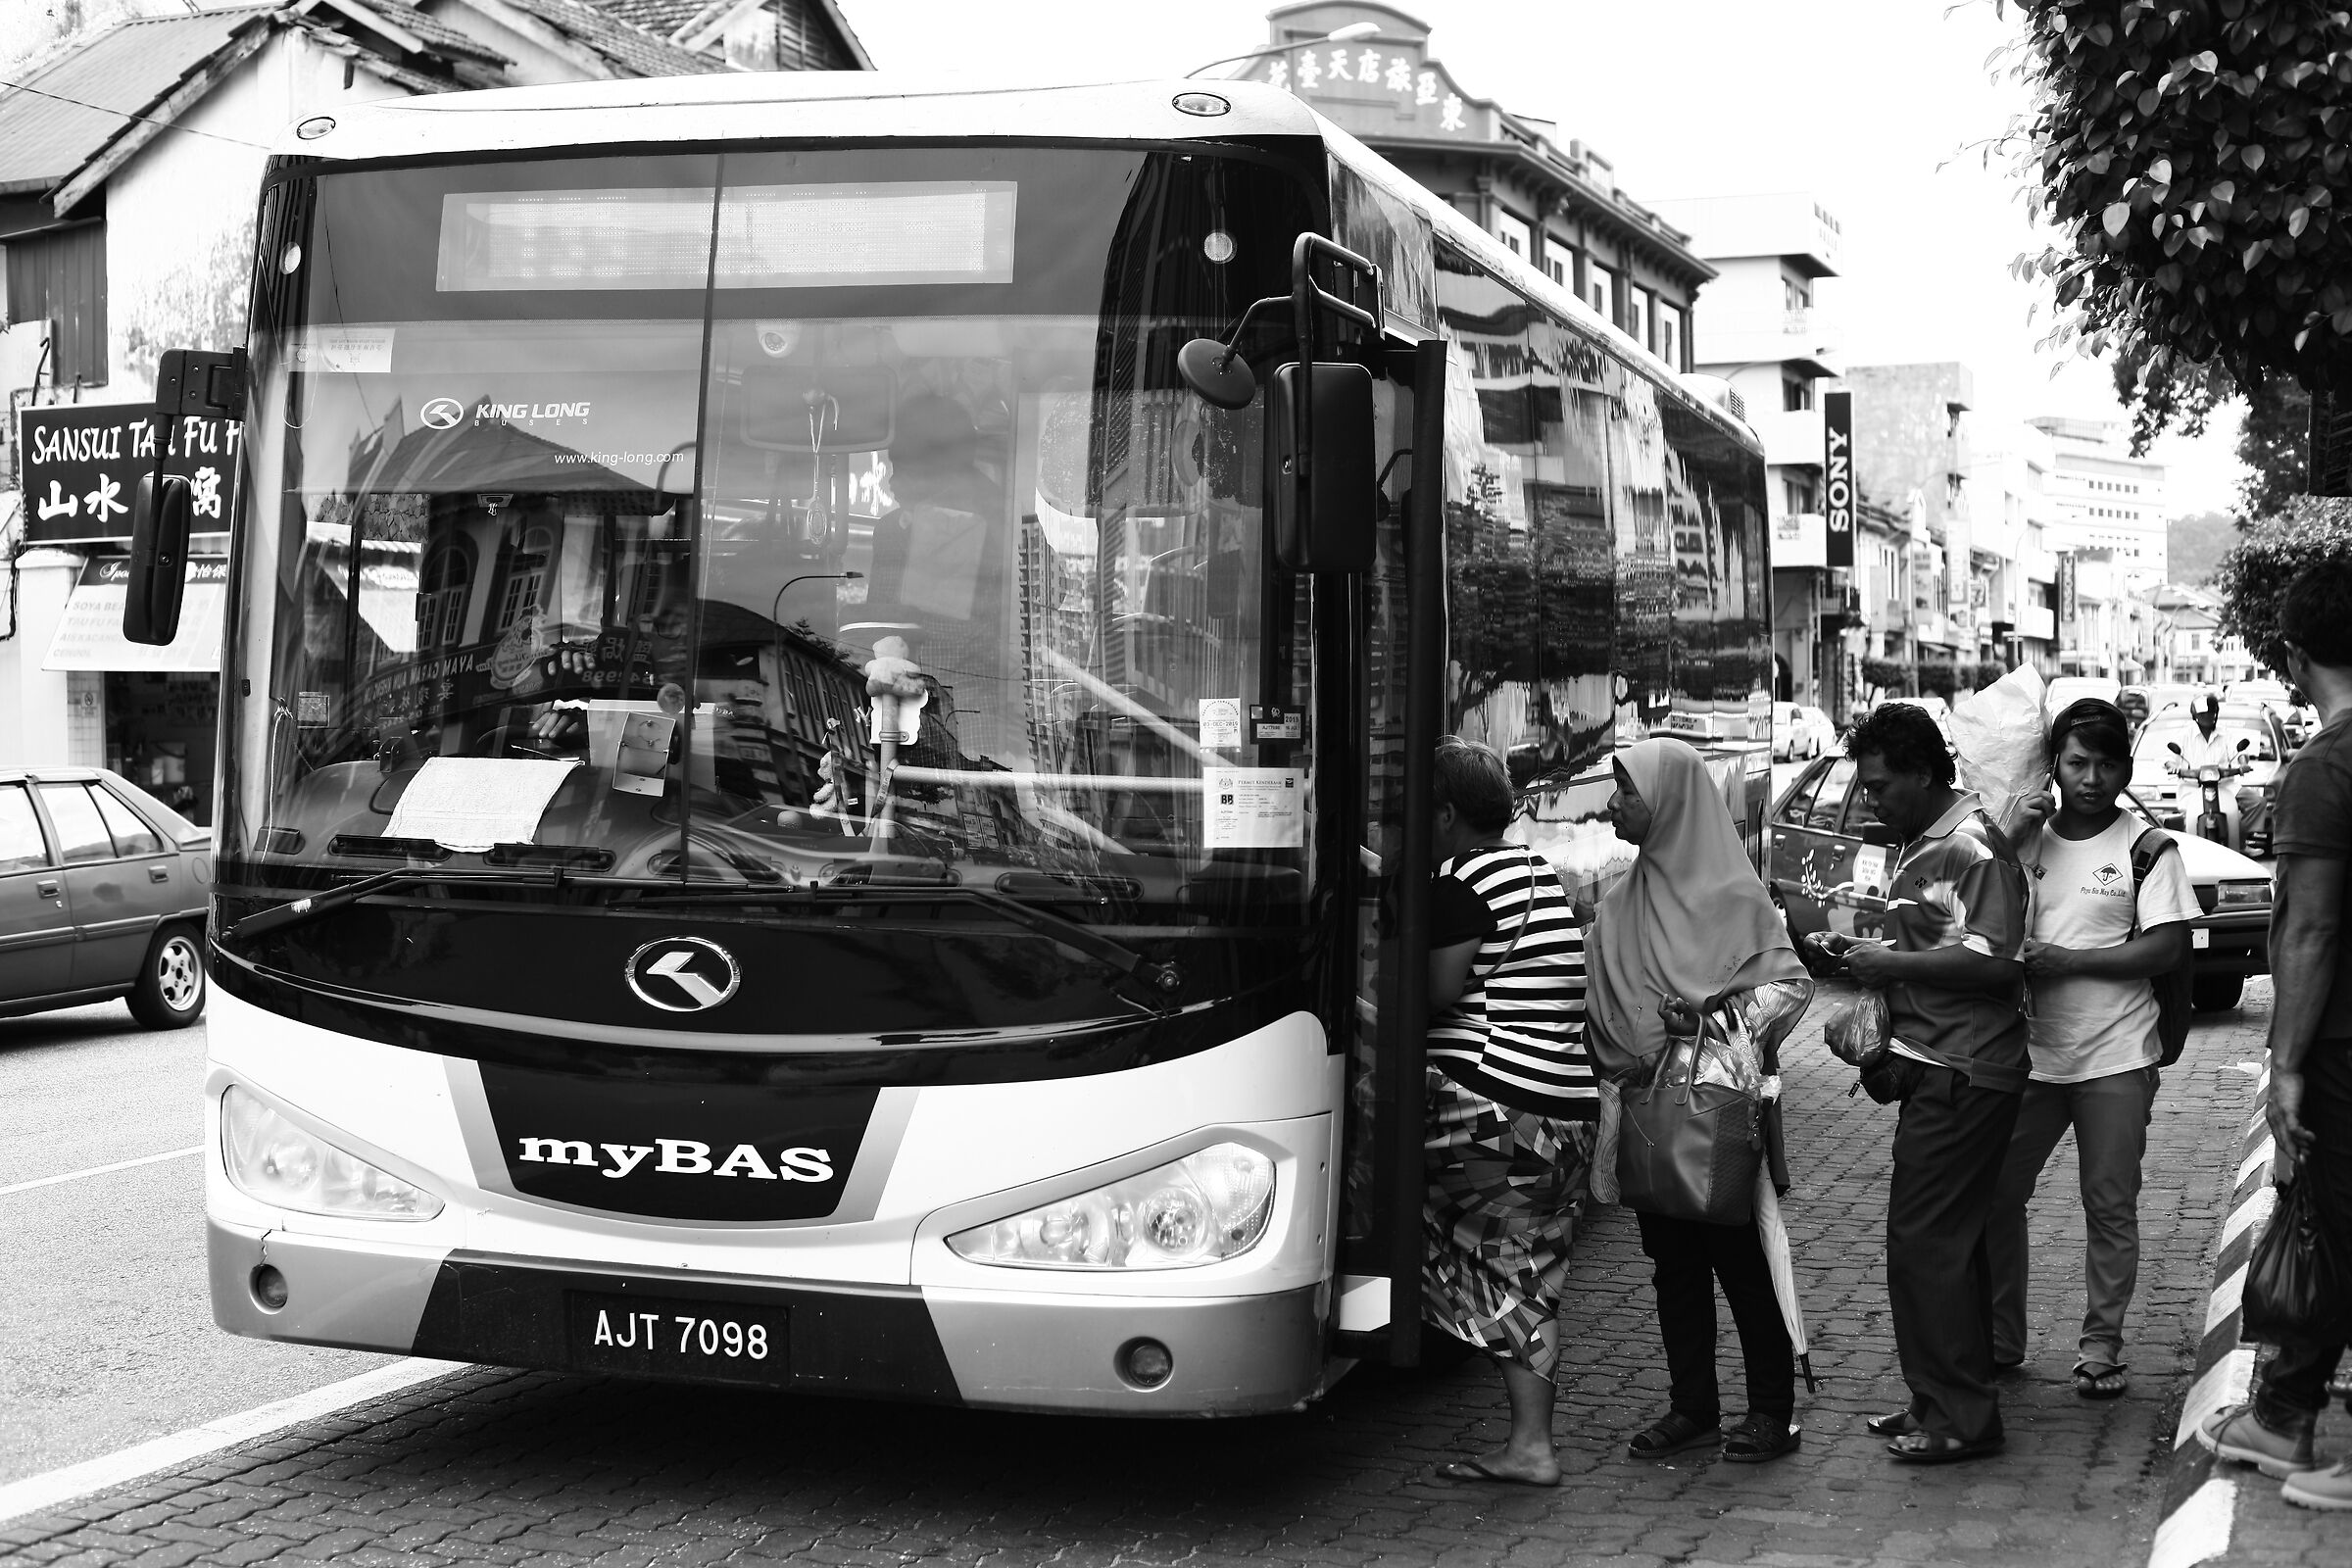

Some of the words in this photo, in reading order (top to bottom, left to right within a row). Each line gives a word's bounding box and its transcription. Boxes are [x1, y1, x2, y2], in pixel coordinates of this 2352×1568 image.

[474, 418, 588, 427] BUSES
[475, 404, 528, 419] KING
[531, 402, 591, 418] LONG
[31, 425, 122, 466] SANSUI
[183, 416, 218, 458] FU
[554, 451, 684, 466] www.king-long.com
[1828, 426, 1850, 532] SONY
[73, 601, 101, 612] SOYA
[104, 602, 125, 612] BEA
[518, 1137, 834, 1183] myBAS
[593, 1309, 660, 1350] AJT
[675, 1315, 768, 1360] 7098
